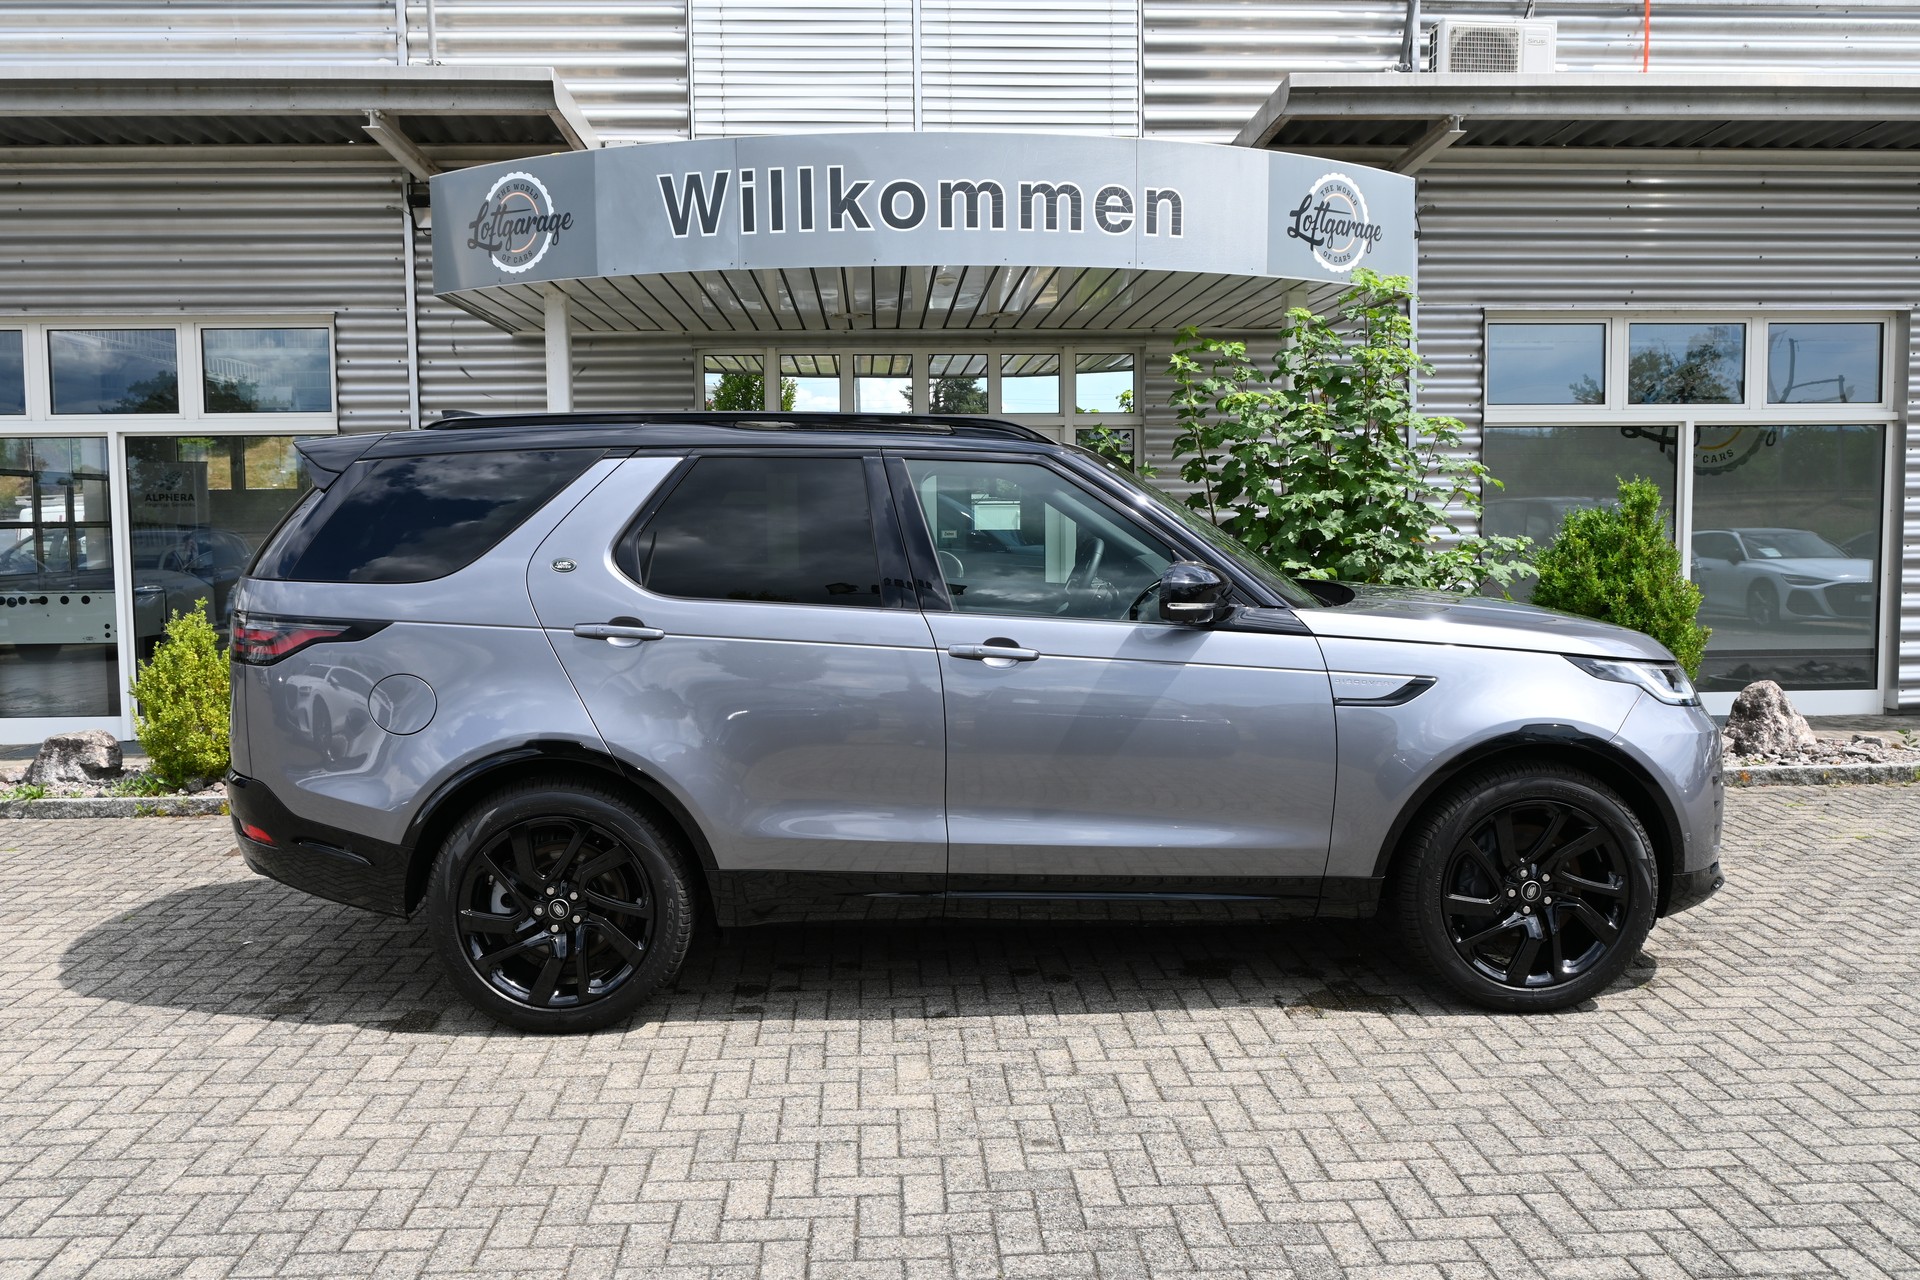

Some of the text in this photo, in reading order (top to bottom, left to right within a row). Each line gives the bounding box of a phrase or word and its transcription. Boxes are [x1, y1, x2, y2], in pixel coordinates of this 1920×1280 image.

[496, 184, 539, 201] THE WORLD
[1320, 184, 1358, 206] THE WORLD
[656, 165, 1184, 239] Willkommen
[467, 201, 574, 258] Loftgarage
[1287, 194, 1383, 254] Loftgarage
[501, 250, 533, 264] OF CARS
[1322, 250, 1352, 263] OF CARS
[1702, 449, 1735, 464] CARS
[145, 493, 195, 502] ALPHERA
[1335, 678, 1397, 686] DISCOVERY
